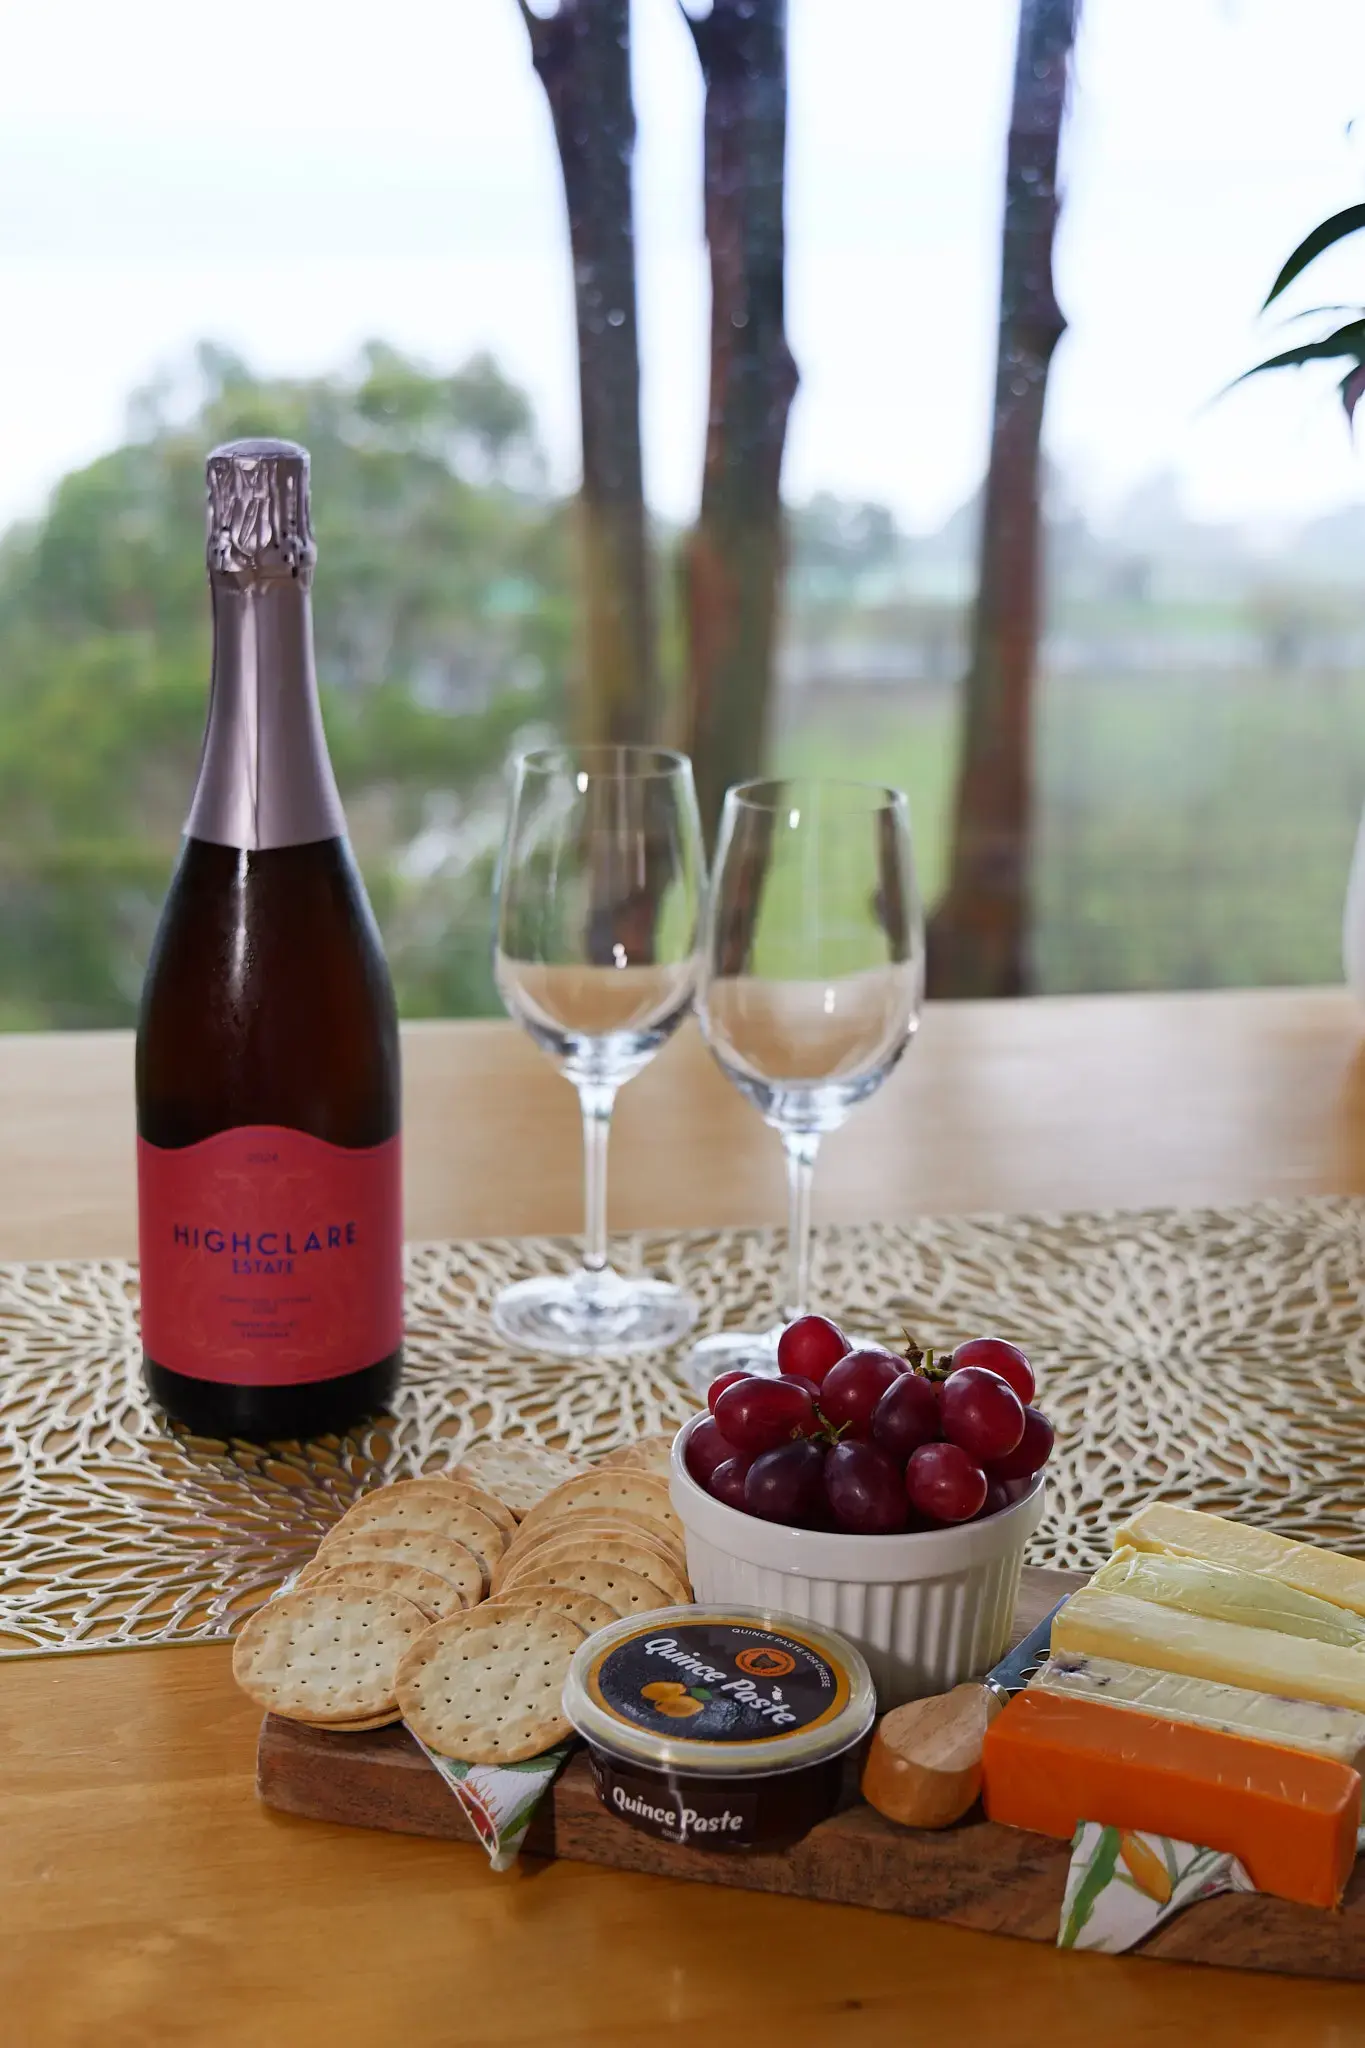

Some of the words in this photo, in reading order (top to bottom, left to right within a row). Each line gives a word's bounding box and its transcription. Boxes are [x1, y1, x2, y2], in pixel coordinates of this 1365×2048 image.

[173, 1220, 358, 1256] HIGHCLARE
[232, 1259, 294, 1275] ESTATE
[644, 1637, 727, 1683] Quince
[720, 1678, 797, 1725] Paste
[731, 1627, 774, 1641] QUINCE
[774, 1637, 804, 1653] PASTE
[802, 1652, 819, 1665] FOR
[814, 1663, 831, 1688] CHEESE
[612, 1785, 677, 1827] Quince
[680, 1808, 744, 1833] Paste
